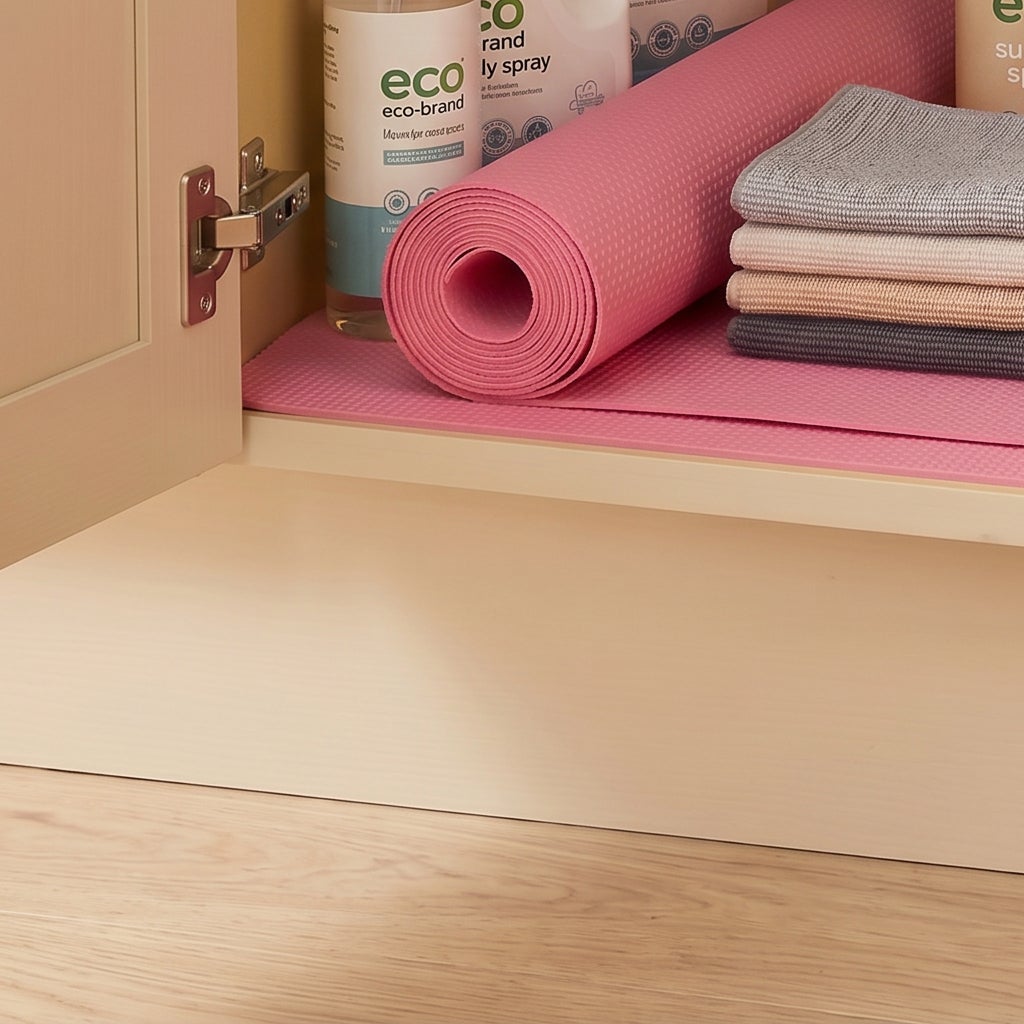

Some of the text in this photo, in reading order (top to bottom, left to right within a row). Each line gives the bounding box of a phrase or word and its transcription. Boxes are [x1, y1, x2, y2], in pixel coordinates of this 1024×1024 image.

[482, 29, 525, 52] rand
[481, 55, 551, 80] ly spray
[380, 61, 465, 101] eco
[382, 93, 465, 118] eco-brand
